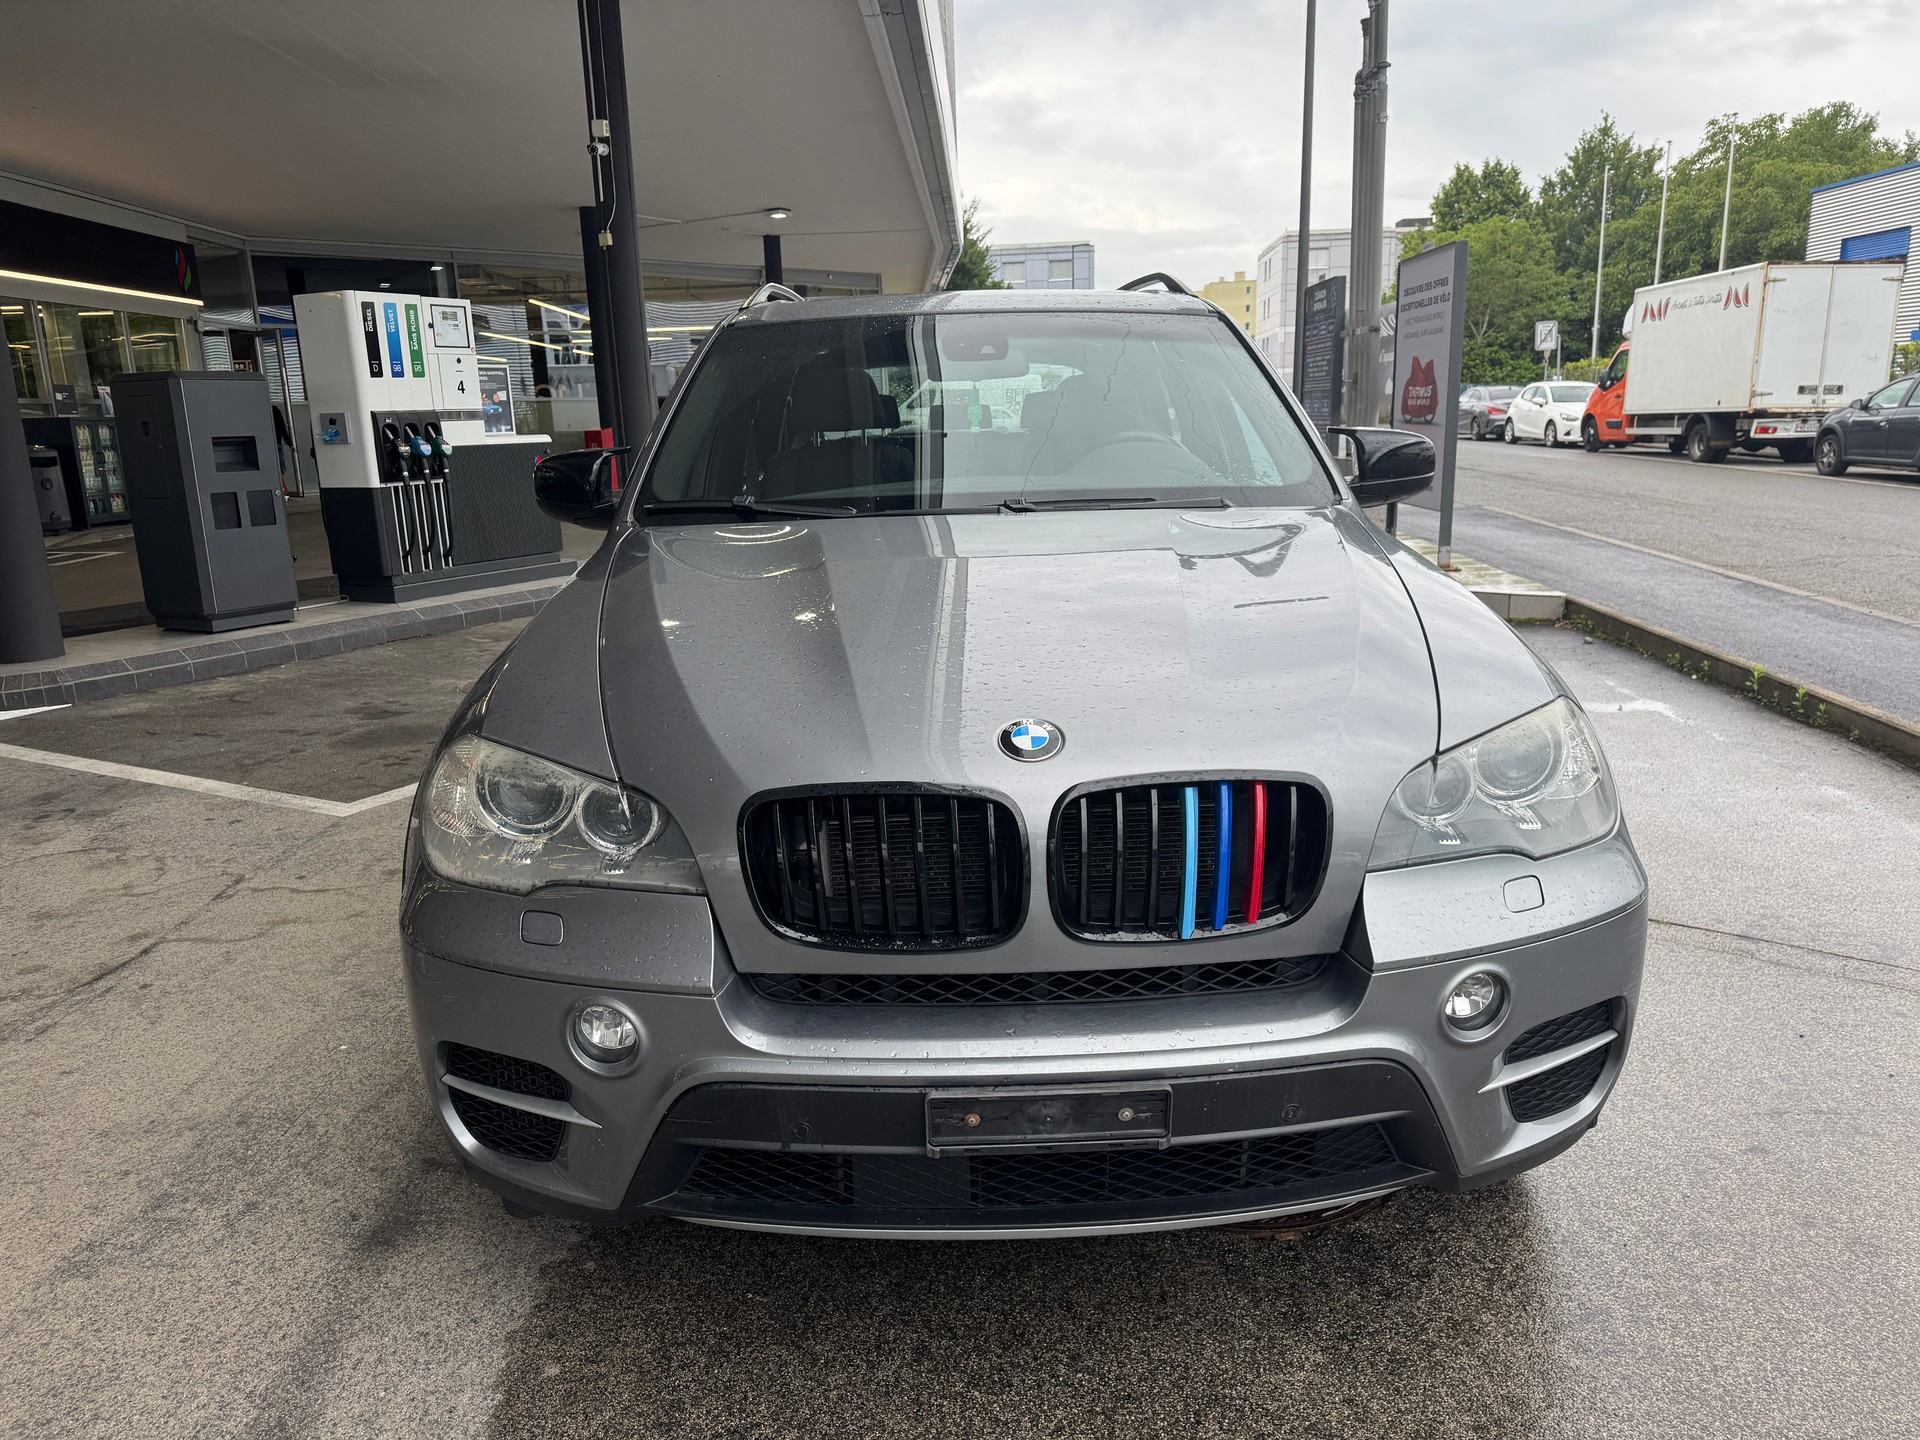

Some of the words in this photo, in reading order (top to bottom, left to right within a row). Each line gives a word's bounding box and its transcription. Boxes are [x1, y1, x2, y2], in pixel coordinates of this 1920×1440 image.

[1403, 284, 1424, 297] DÉCOUVRE
[1424, 281, 1432, 291] DES
[1433, 277, 1449, 289] OFFRES
[1433, 295, 1439, 305] DE
[1439, 290, 1451, 302] VÉLO
[366, 308, 374, 332] DIESEL
[388, 309, 396, 333] VELVET
[409, 310, 417, 332] PLOMB
[373, 364, 379, 372] D
[393, 364, 402, 372] 98
[414, 364, 422, 372] 95
[457, 380, 466, 394] 4
[1007, 719, 1055, 732] BMW
